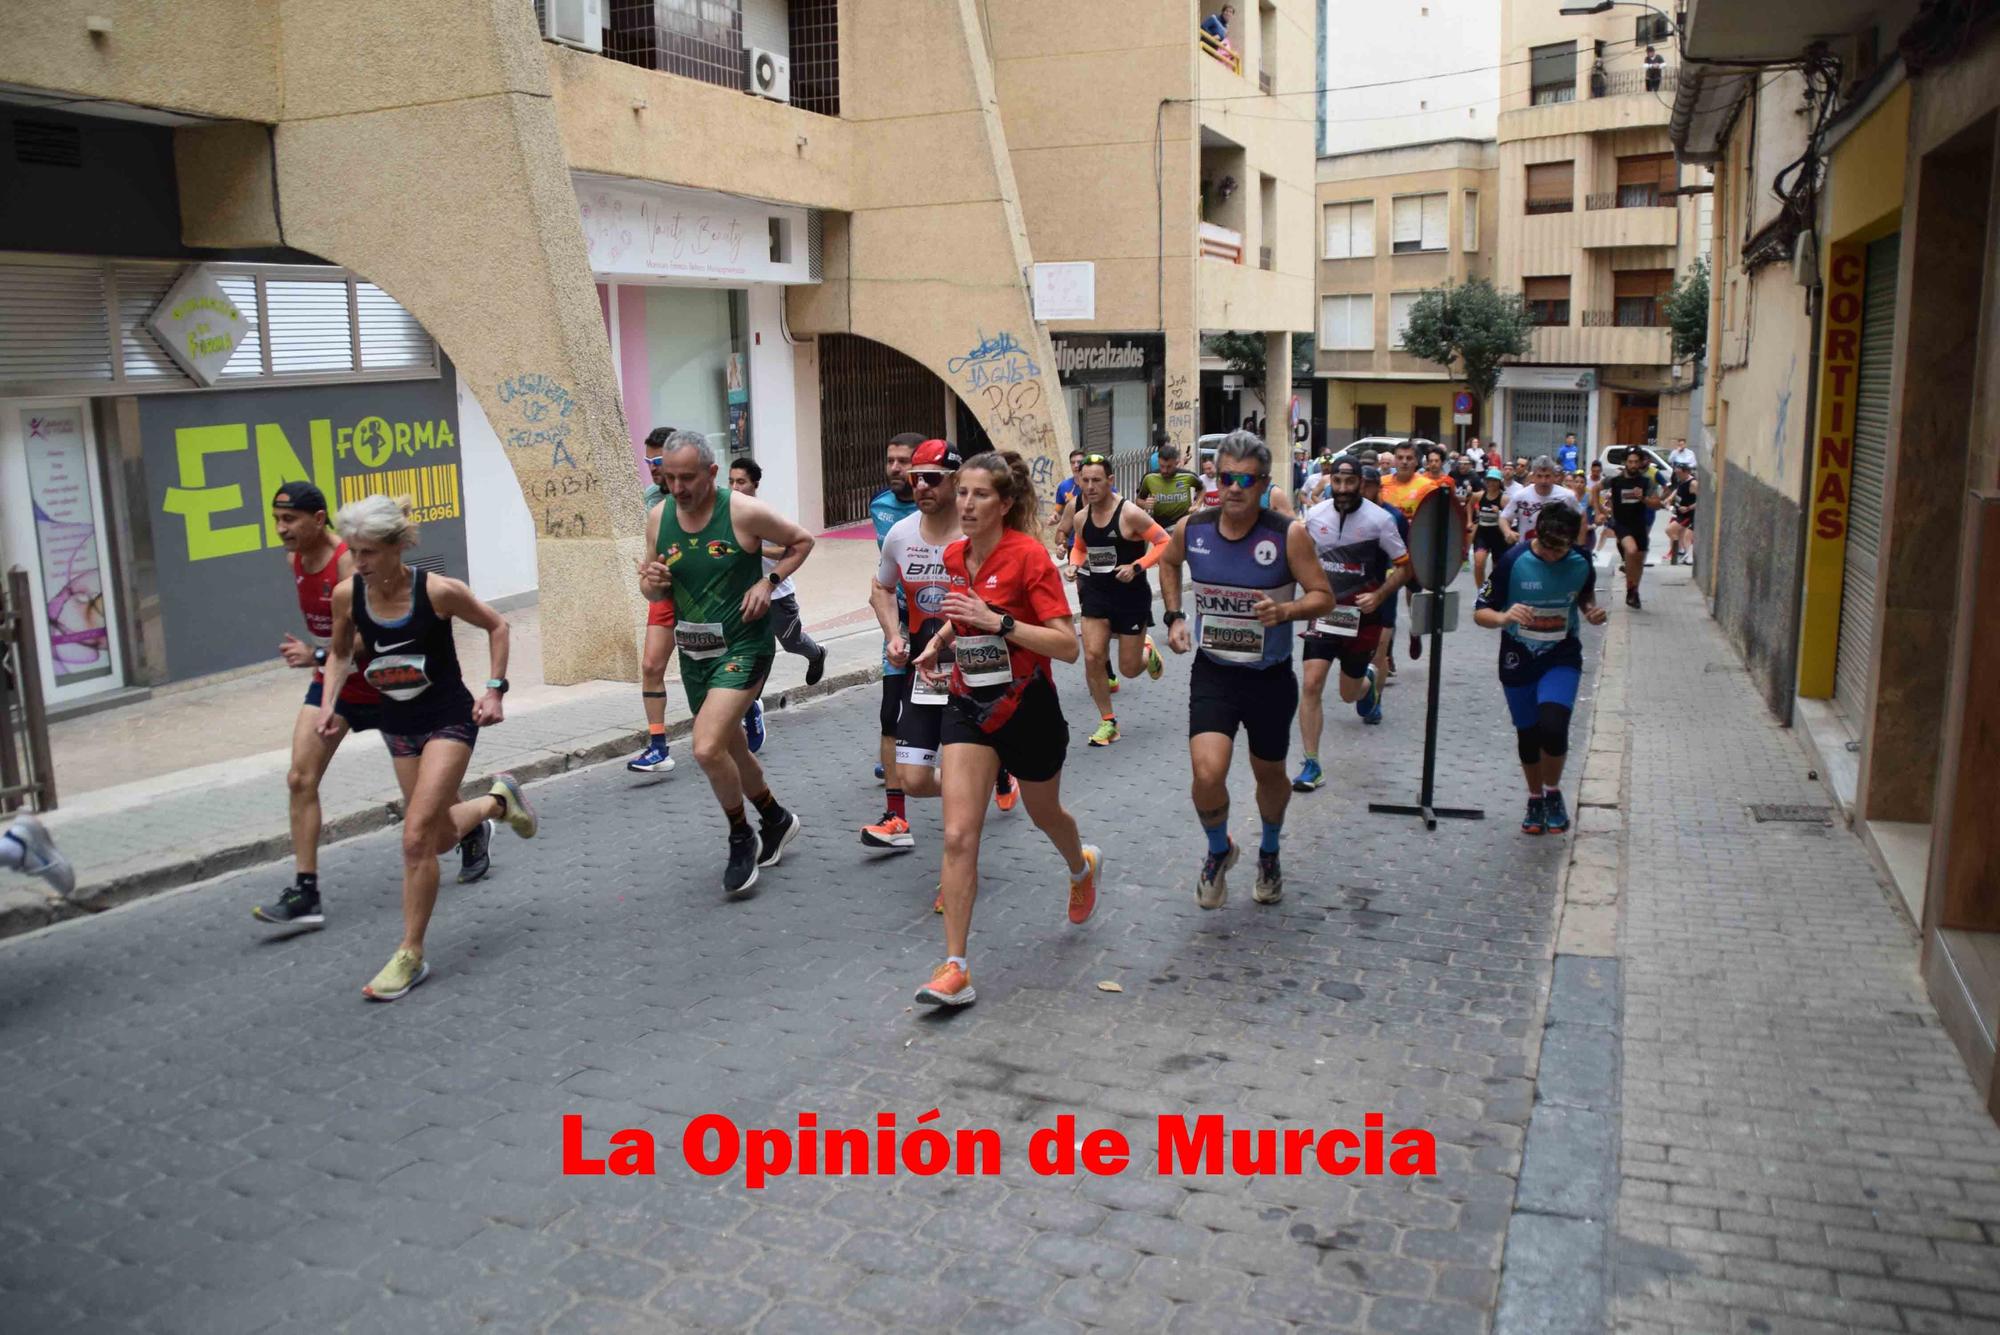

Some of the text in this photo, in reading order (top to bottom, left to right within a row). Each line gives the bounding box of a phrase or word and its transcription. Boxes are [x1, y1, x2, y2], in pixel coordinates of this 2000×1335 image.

[1052, 339, 1145, 378] Hipercalzados
[1815, 253, 1861, 541] CORTINAS
[163, 418, 341, 562] EN
[336, 416, 455, 468] FORMA
